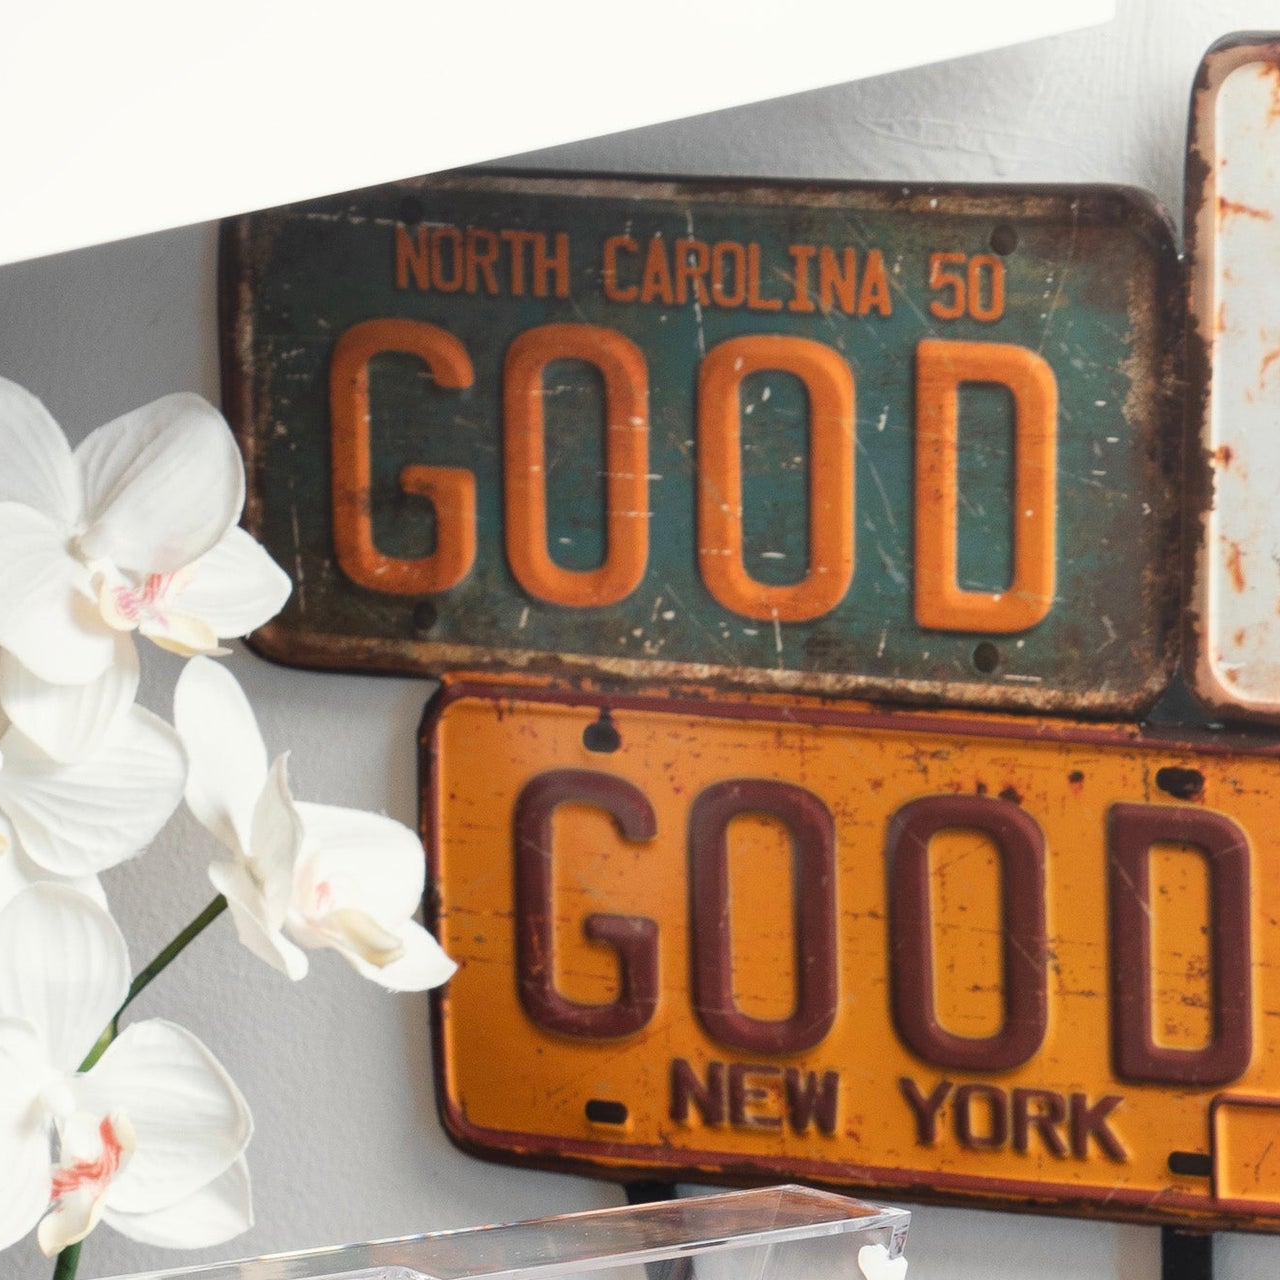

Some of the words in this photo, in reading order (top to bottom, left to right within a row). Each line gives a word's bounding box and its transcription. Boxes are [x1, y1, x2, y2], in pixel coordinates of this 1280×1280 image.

[396, 226, 570, 298] NORTH
[604, 235, 893, 318] CAROLINA
[929, 251, 1006, 324] 50
[330, 317, 1059, 635] GOOD
[514, 767, 1254, 1087] GOOD
[668, 1056, 840, 1137] NEW
[899, 1075, 1129, 1162] YORK
